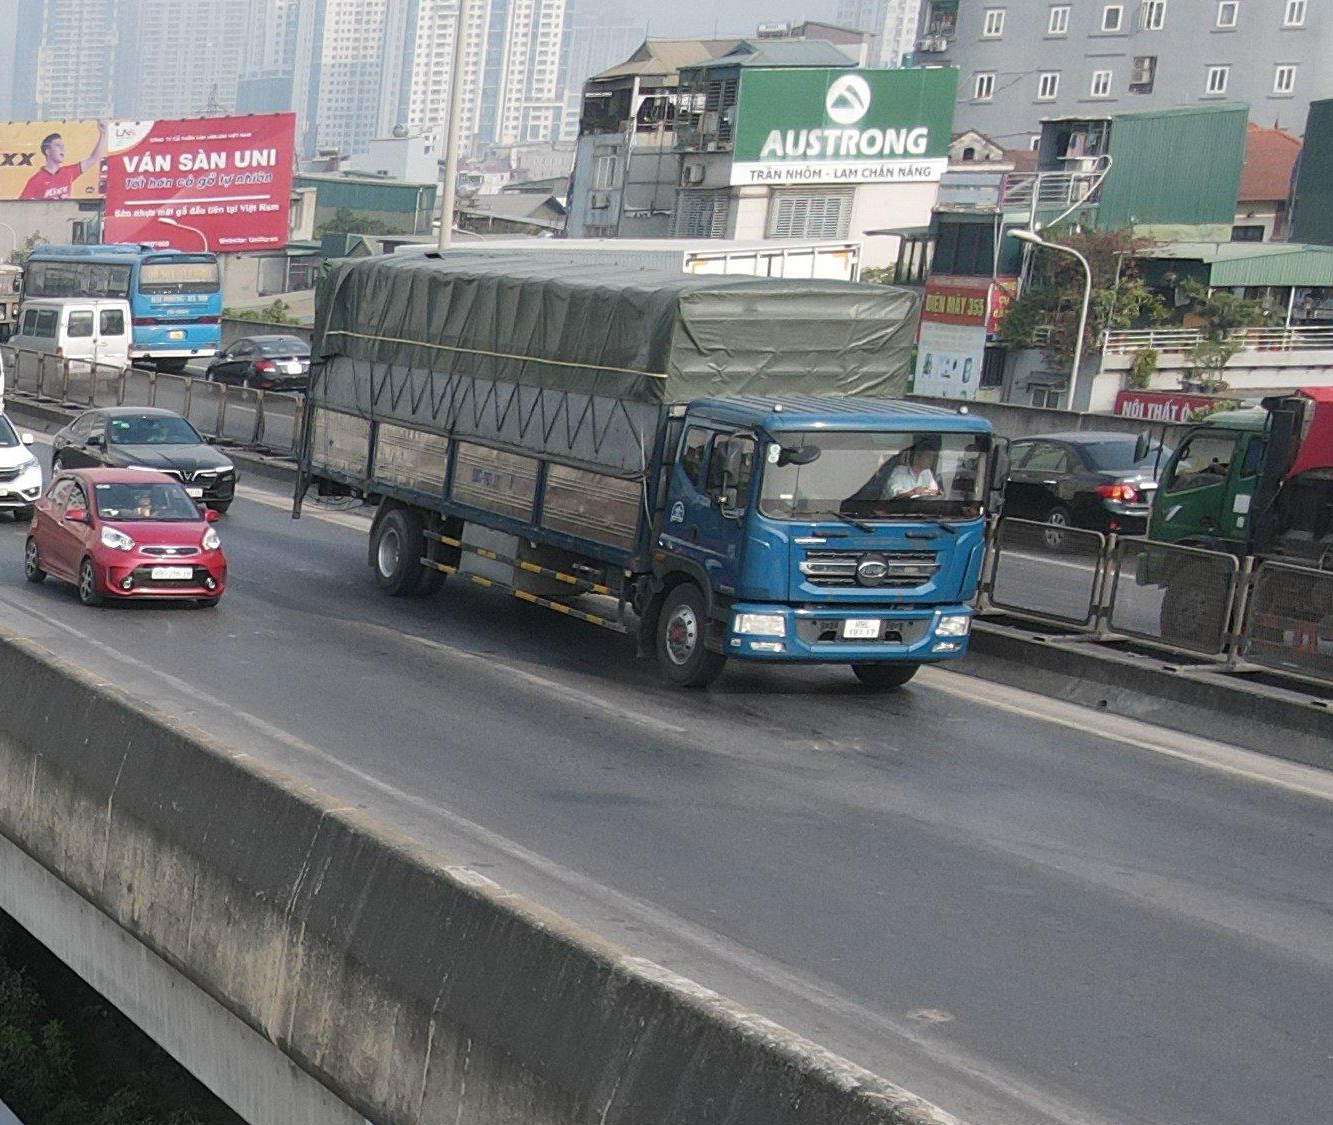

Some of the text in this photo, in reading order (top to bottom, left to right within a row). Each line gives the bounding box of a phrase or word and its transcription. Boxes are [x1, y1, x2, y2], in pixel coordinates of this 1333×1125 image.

[759, 126, 929, 157] AUSTRONG
[122, 149, 277, 173] VÁN SÀN UNI
[834, 167, 858, 179] LAM
